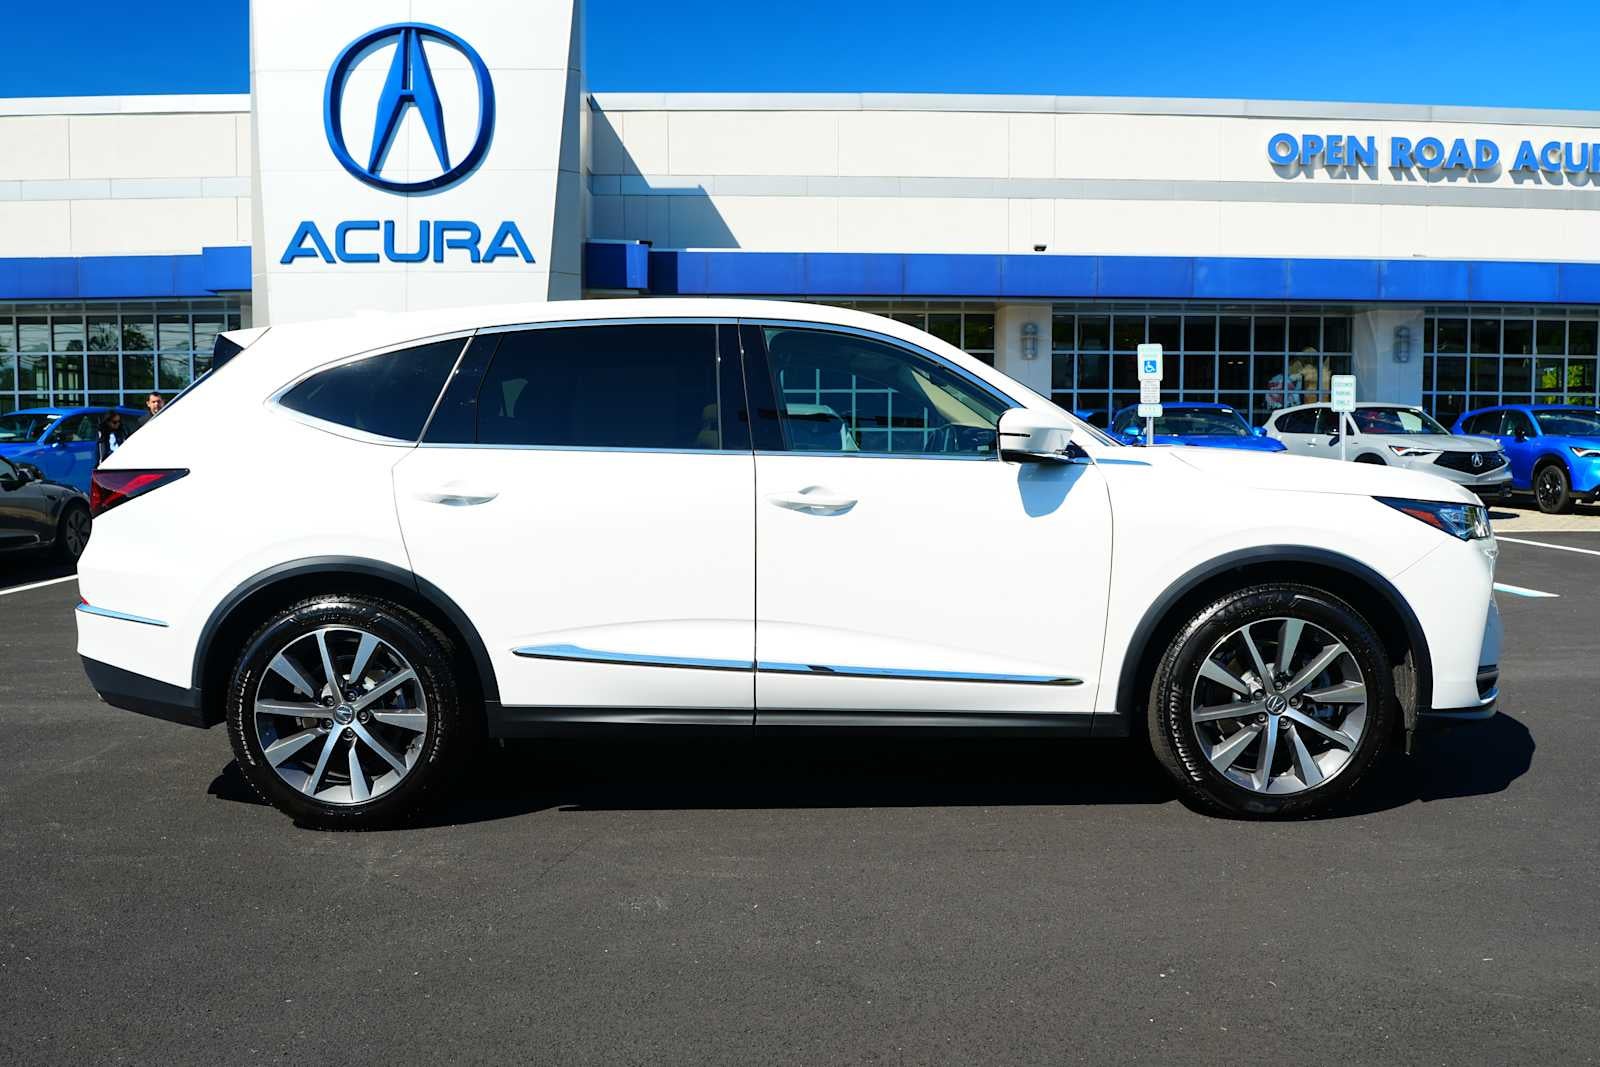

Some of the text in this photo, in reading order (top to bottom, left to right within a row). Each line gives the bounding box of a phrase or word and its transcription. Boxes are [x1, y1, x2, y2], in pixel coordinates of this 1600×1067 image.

[1267, 133, 1375, 166] OPEN
[1391, 137, 1500, 170] ROAD
[280, 220, 536, 264] ACURA
